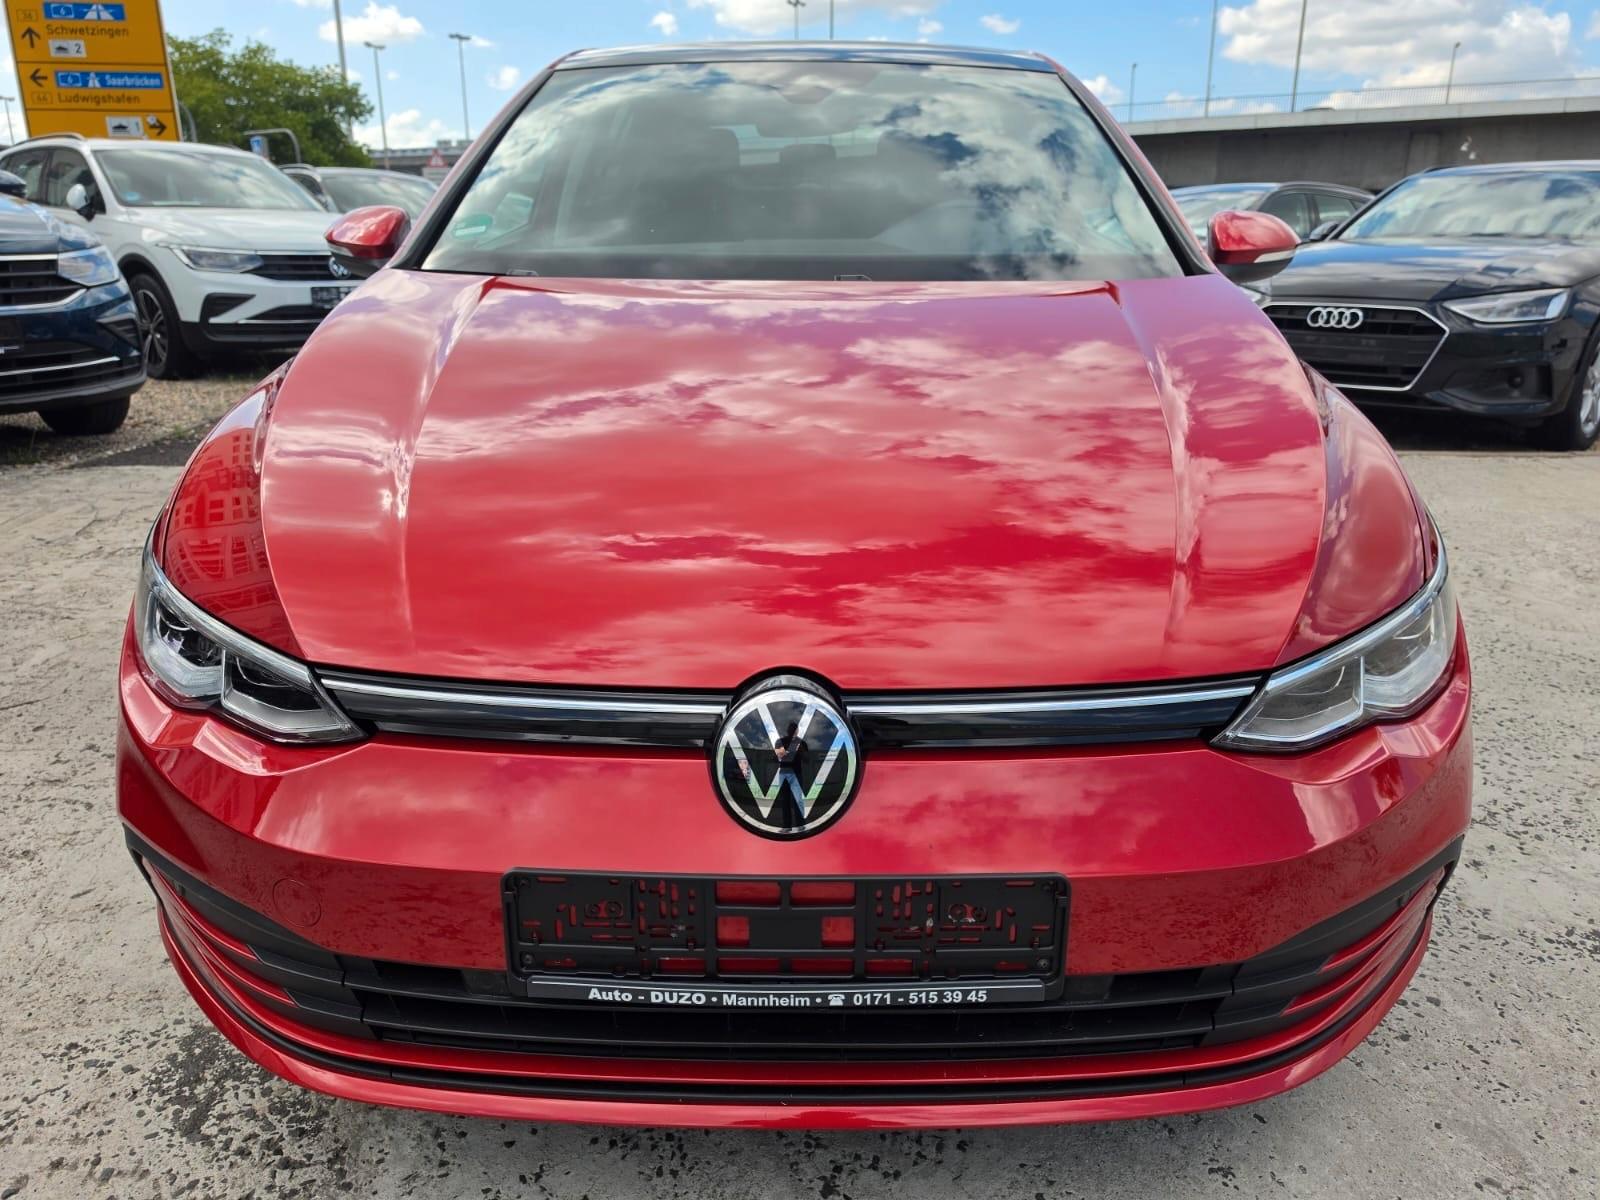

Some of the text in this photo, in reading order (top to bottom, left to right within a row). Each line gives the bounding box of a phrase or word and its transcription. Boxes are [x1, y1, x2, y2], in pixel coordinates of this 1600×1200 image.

[46, 24, 129, 38] Schwetzingen
[74, 43, 82, 54] 2
[105, 74, 161, 86] Saarbrücken
[57, 93, 140, 105] Ludwigshafen
[588, 988, 633, 1002] Auto
[651, 991, 706, 1005] DUZO
[722, 994, 811, 1007] Mannheim
[853, 993, 891, 1006] 0171
[908, 991, 938, 1004] 515
[942, 990, 963, 1003] 39
[966, 990, 987, 1003] 45
